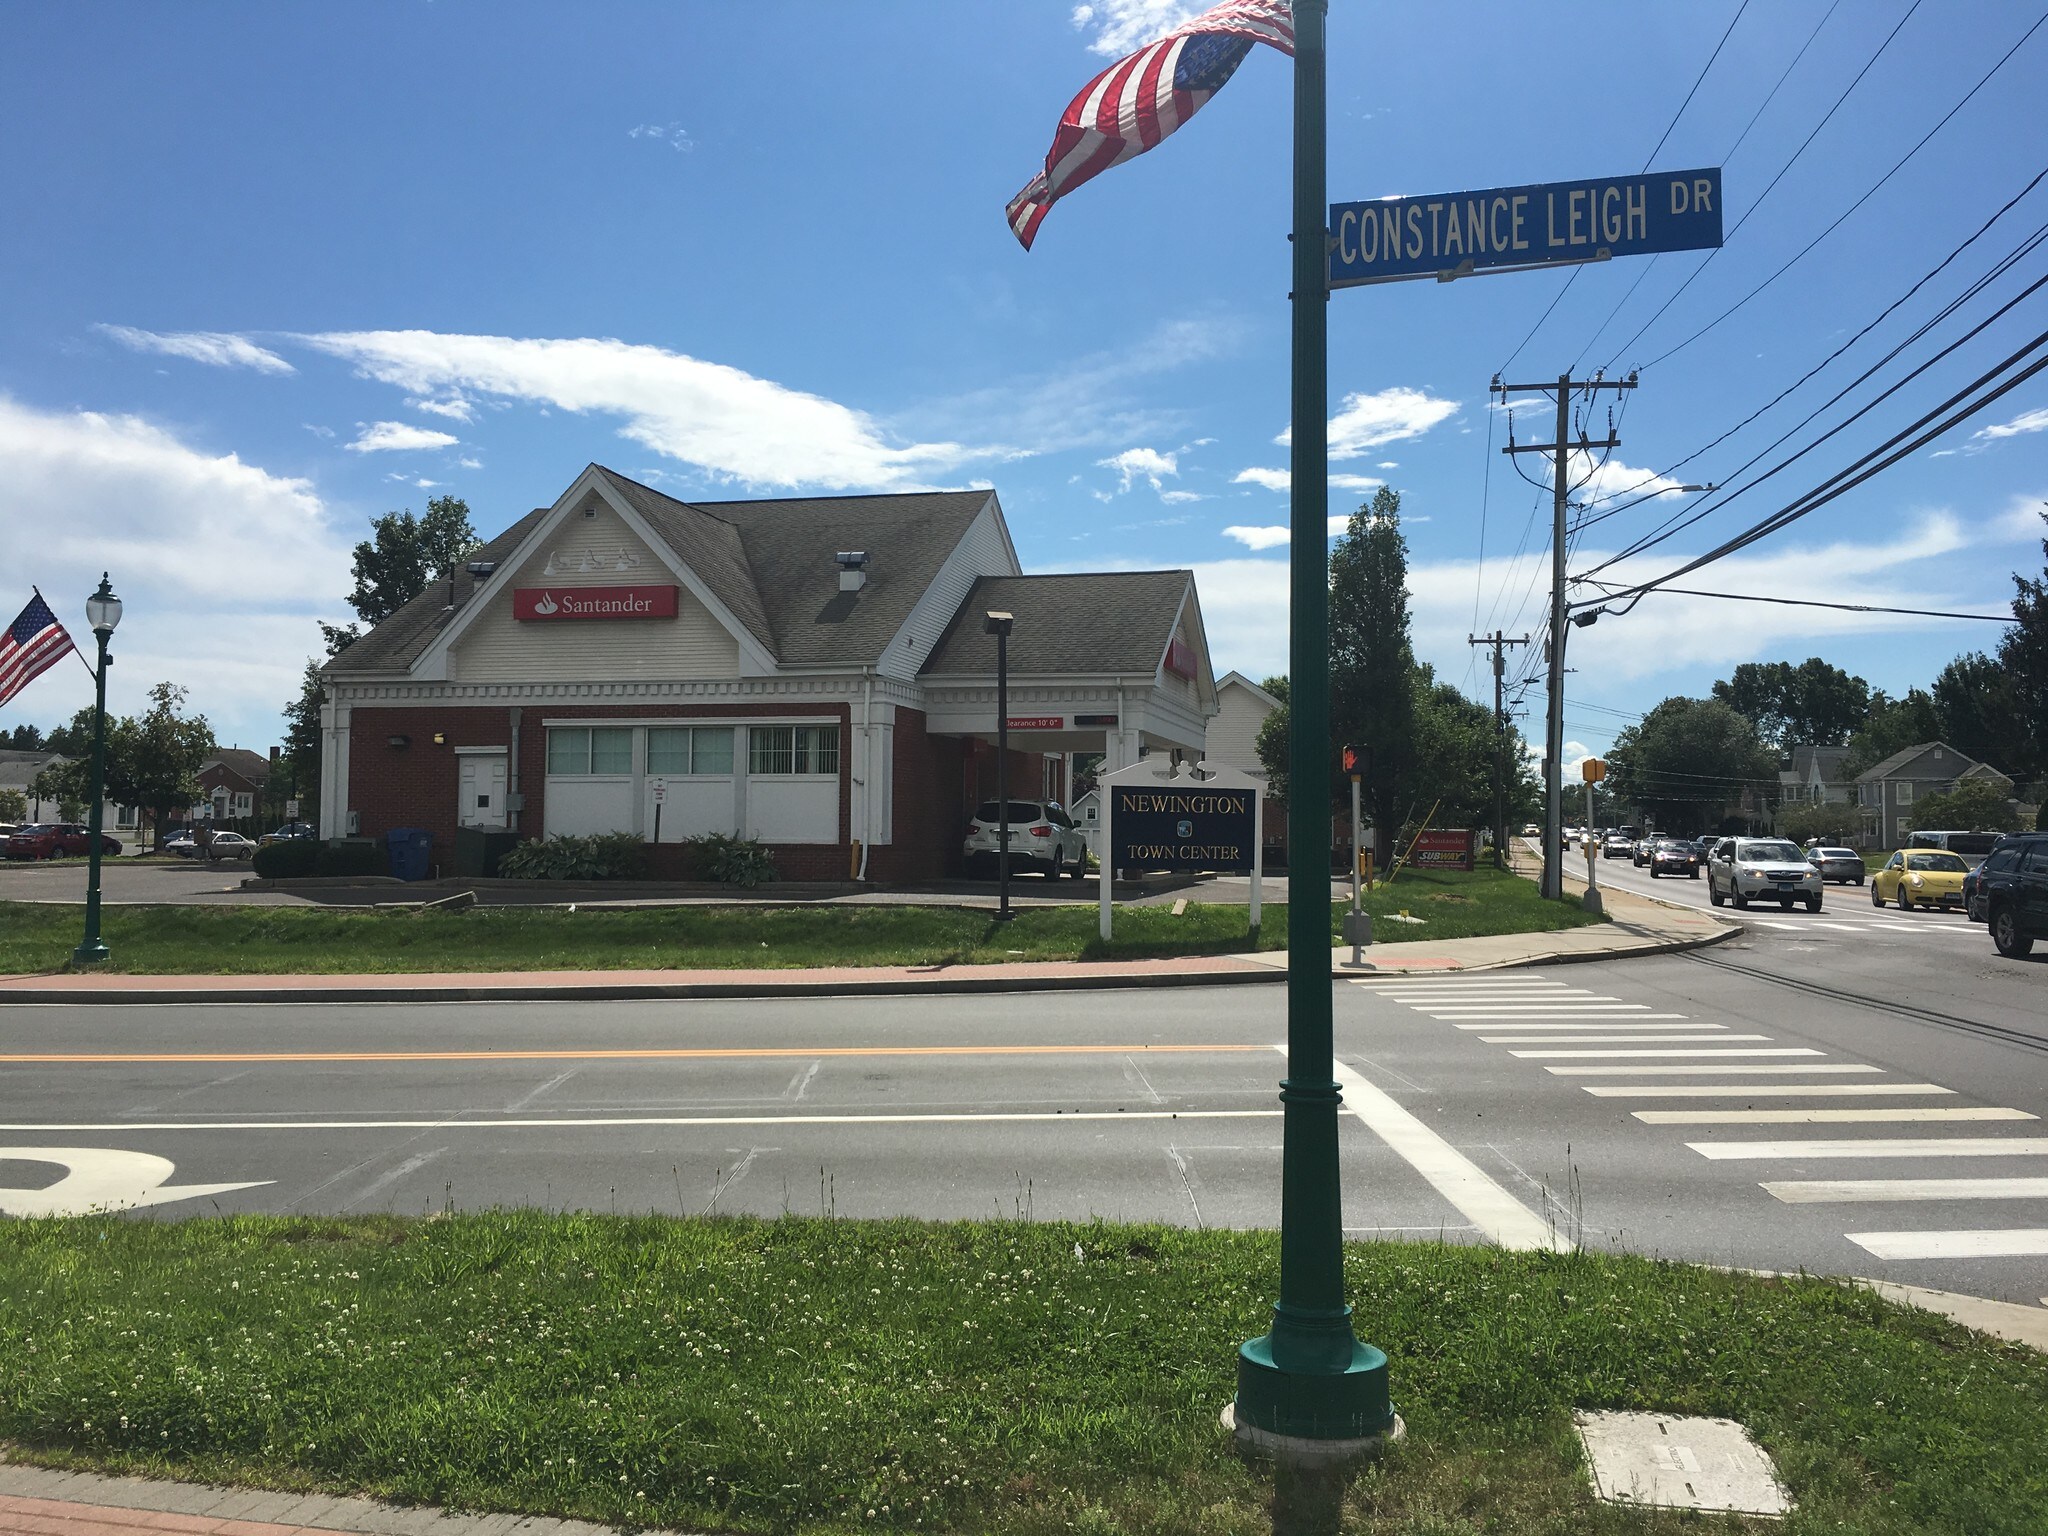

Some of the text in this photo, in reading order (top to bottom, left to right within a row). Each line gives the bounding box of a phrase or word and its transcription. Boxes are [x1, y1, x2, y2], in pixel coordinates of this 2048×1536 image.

[1340, 179, 1712, 264] CONSTANCE LEIGH DR
[562, 594, 652, 613] Santander
[1122, 795, 1245, 814] NEWINGTON
[1128, 845, 1240, 860] TOWN CENTER
[1418, 852, 1465, 860] SUBWAY
